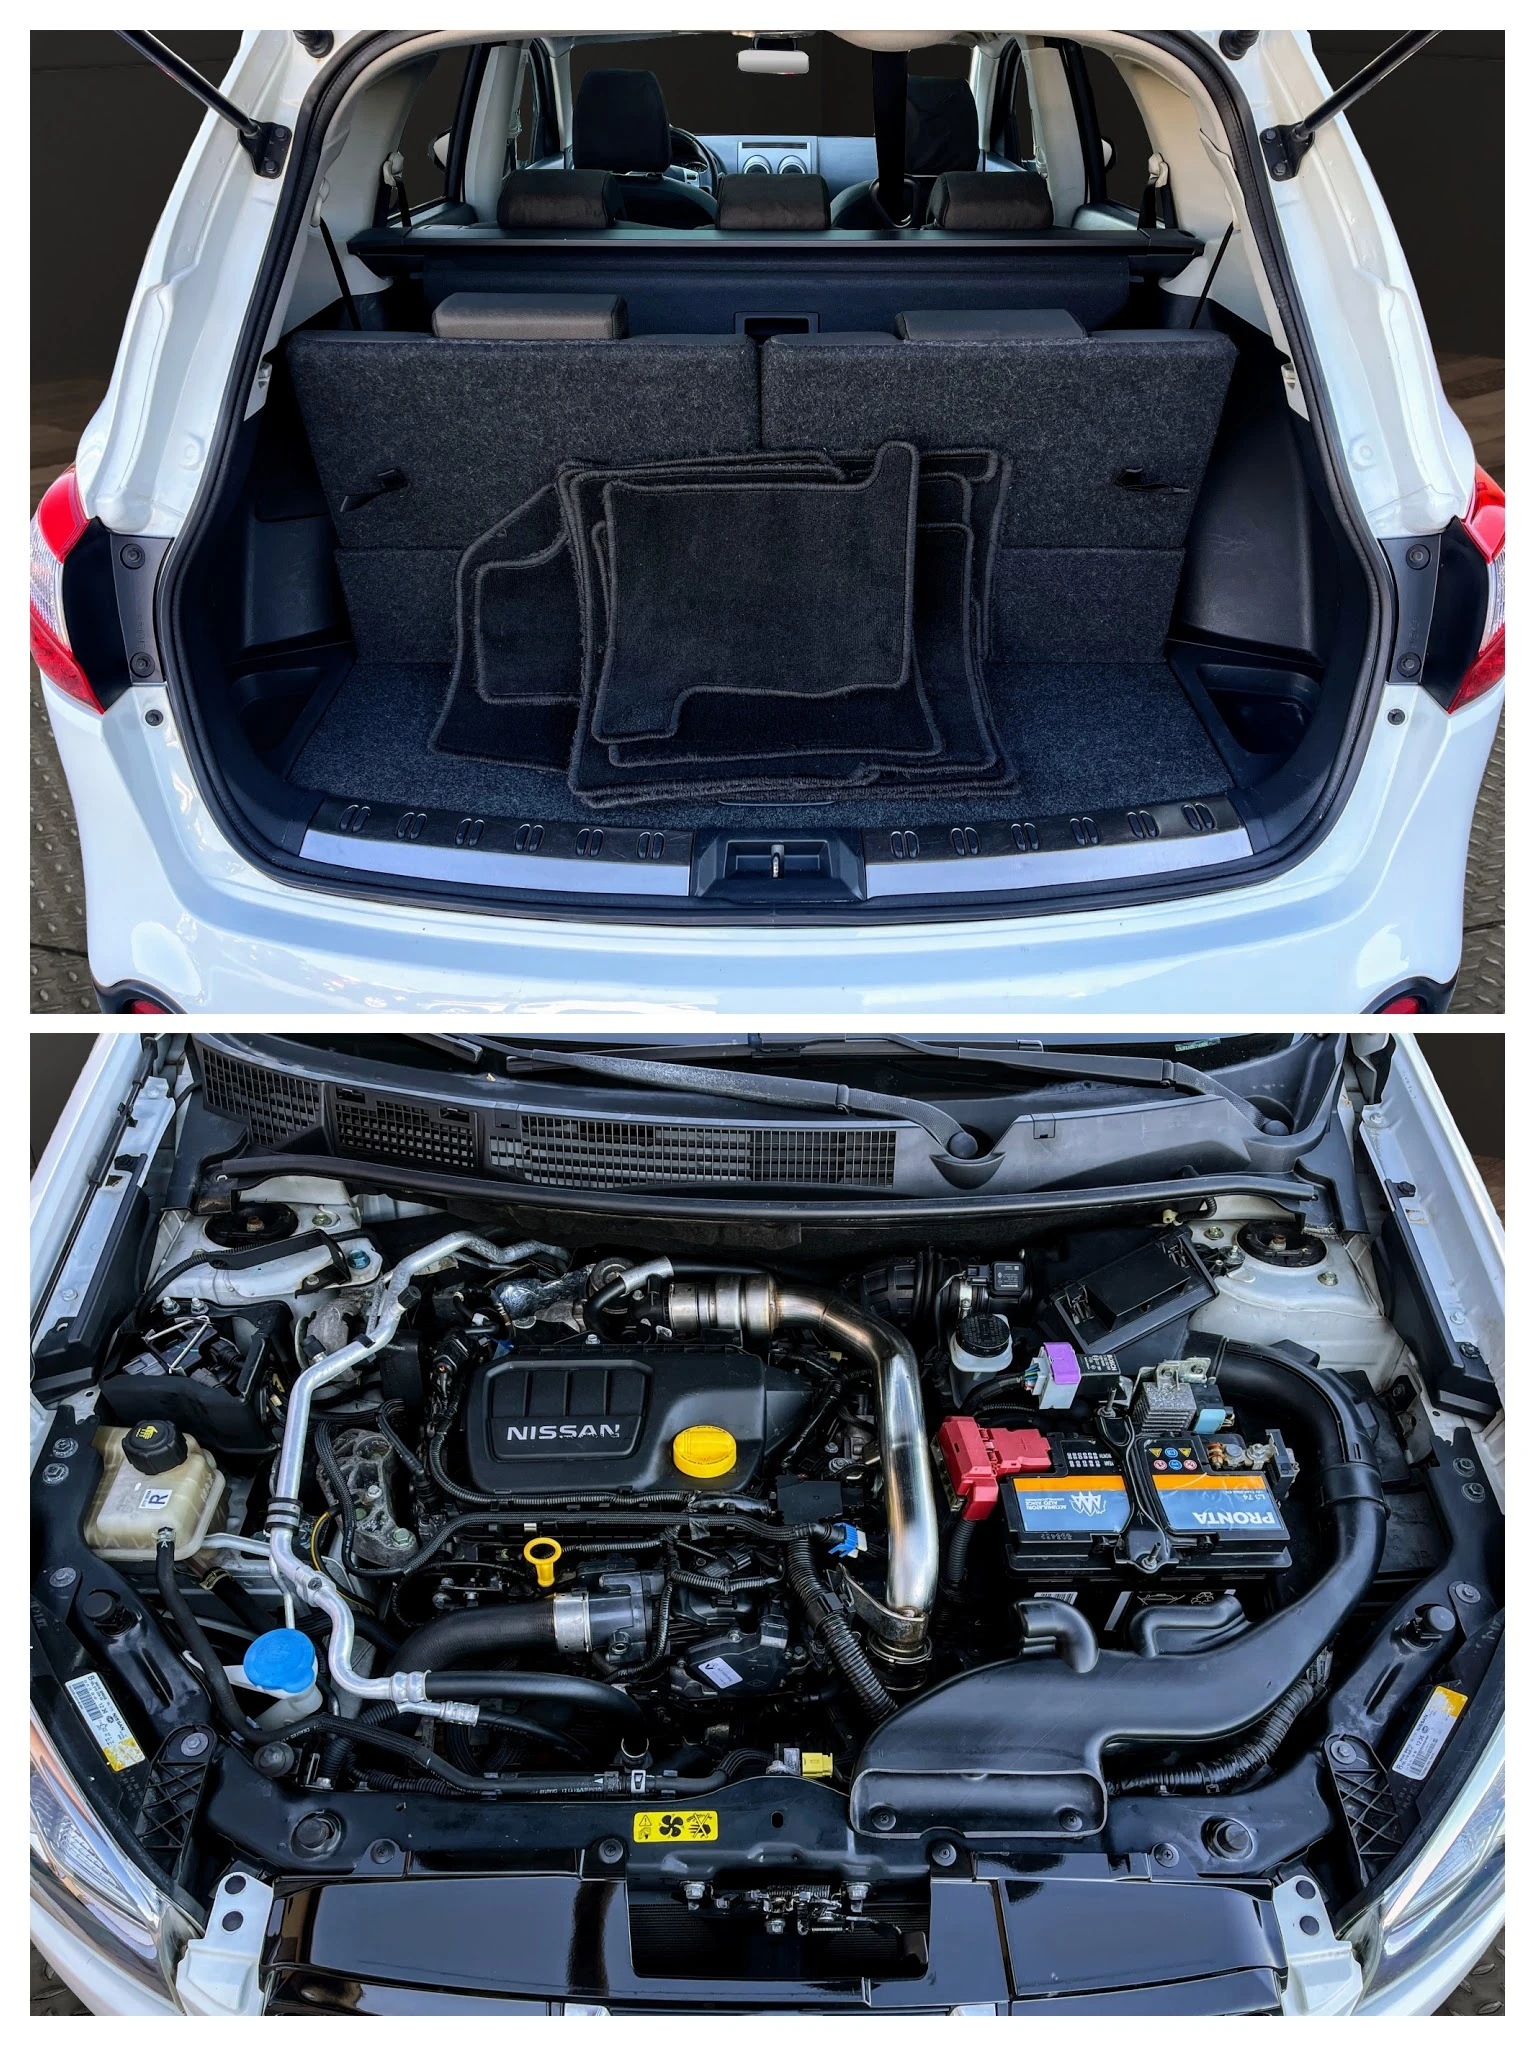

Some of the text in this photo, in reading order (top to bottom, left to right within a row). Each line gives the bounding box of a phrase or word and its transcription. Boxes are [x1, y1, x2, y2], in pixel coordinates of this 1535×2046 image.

[506, 1424, 620, 1441] NISSAN
[148, 1494, 169, 1505] R
[1192, 1511, 1276, 1525] PRONTA
[112, 1712, 126, 1731] NISSAN
